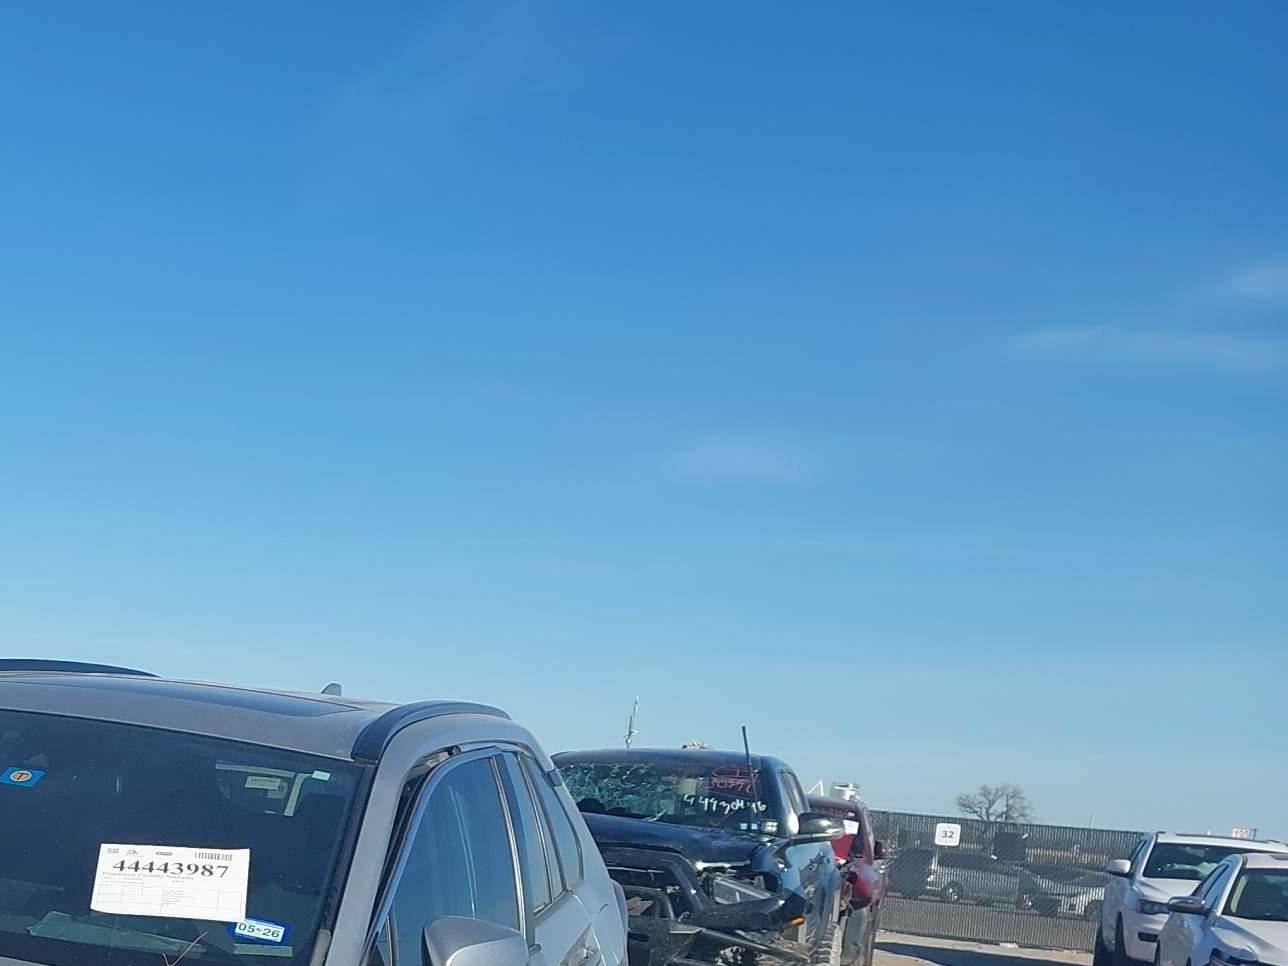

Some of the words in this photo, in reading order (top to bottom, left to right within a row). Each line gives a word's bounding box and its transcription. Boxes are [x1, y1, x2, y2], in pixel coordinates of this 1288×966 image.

[940, 829, 955, 839] 32
[112, 858, 229, 879] 44443987
[238, 922, 256, 933] 05
[261, 927, 281, 938] 26
